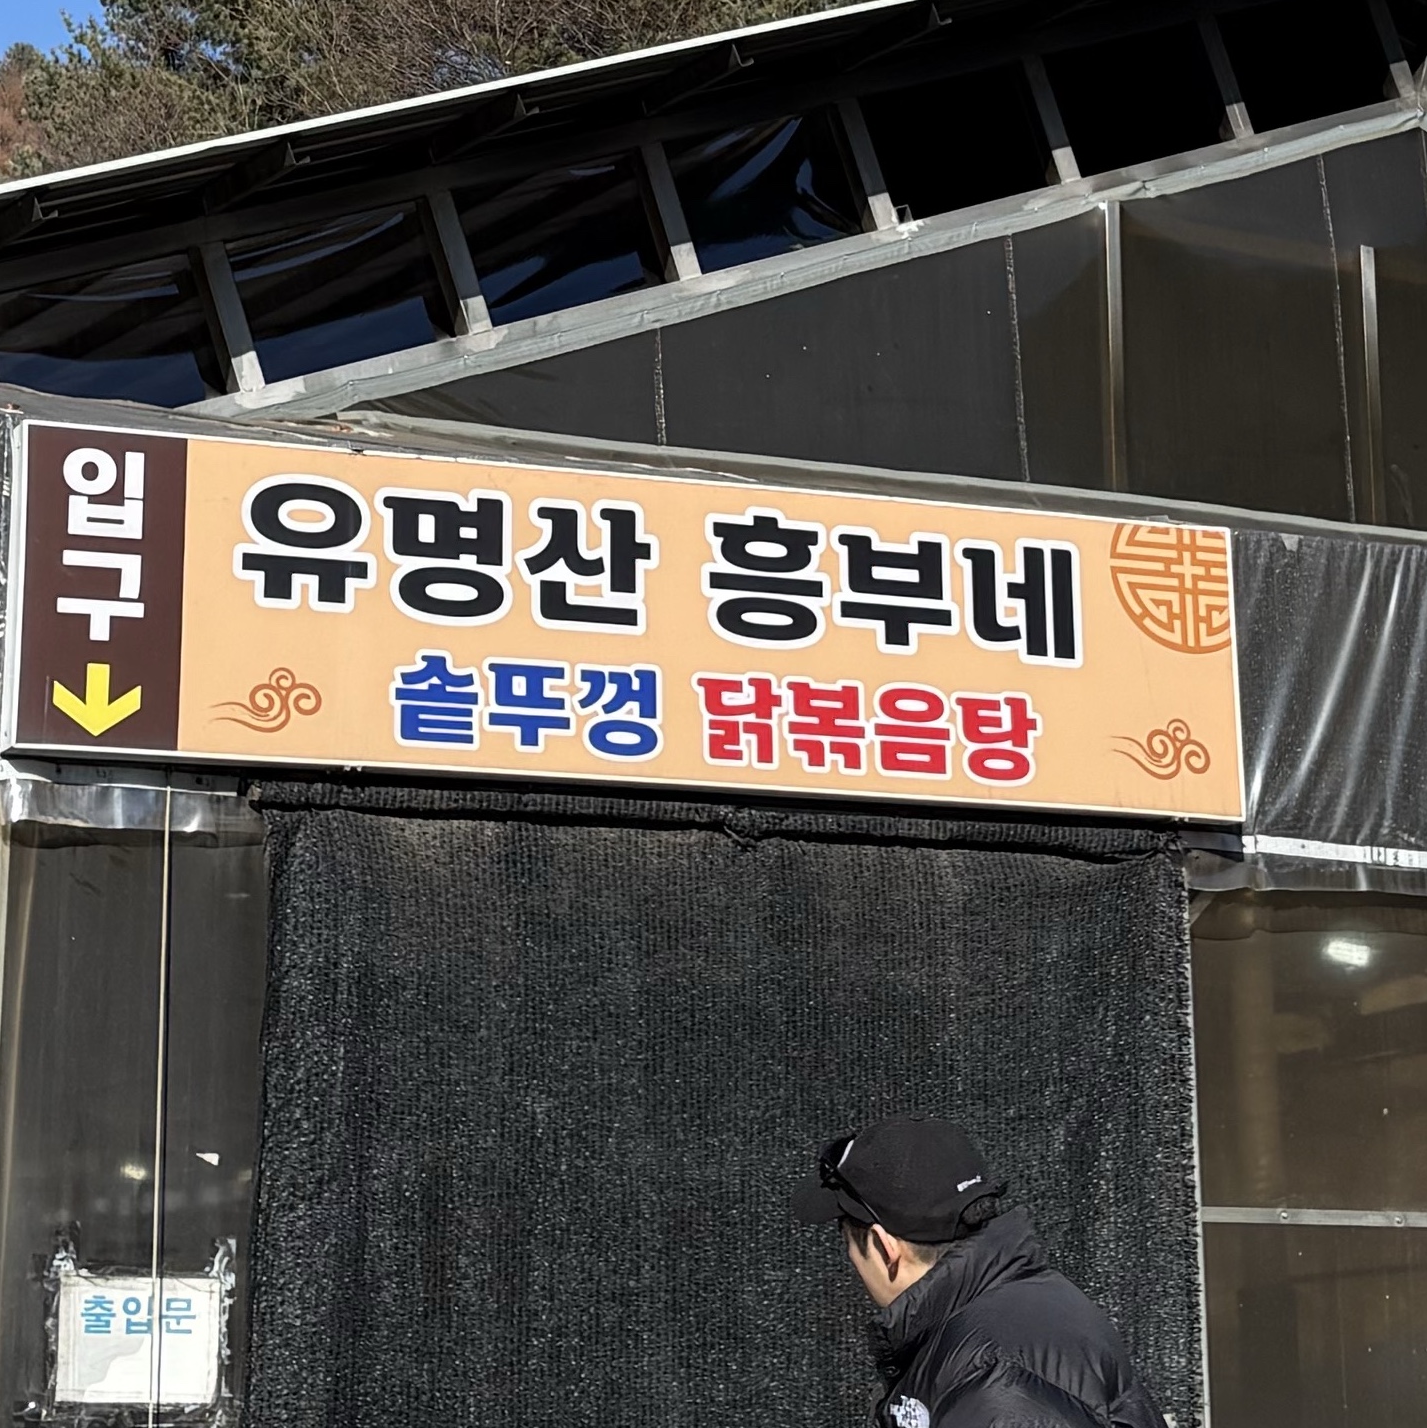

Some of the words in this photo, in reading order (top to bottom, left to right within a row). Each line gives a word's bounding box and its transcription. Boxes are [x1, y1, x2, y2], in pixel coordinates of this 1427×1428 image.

[56, 448, 146, 642] 입구
[239, 480, 653, 627] 유명산
[707, 510, 1078, 662] 흥부네
[394, 654, 658, 757] 솥뚜껑
[698, 677, 1036, 781] 닭볶음탕
[80, 1294, 197, 1335] 출입문
